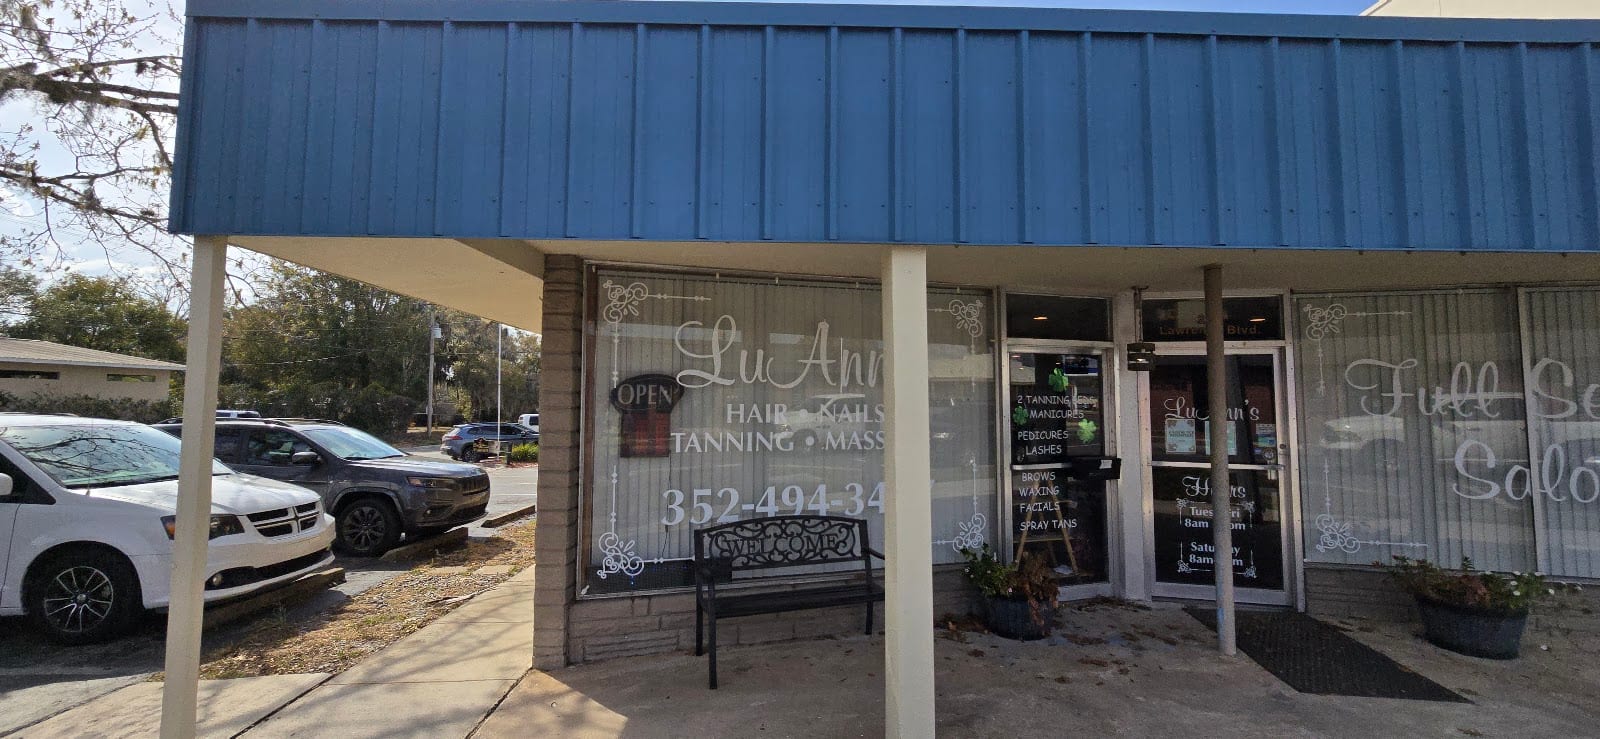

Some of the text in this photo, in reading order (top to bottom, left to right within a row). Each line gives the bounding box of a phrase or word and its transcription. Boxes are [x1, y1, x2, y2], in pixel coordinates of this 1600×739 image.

[617, 383, 673, 405] OPEN
[1345, 358, 1500, 418] Full
[1017, 395, 1023, 404] 2
[1026, 395, 1070, 404] TANNING
[726, 403, 885, 424] HAIR NAILS
[1029, 409, 1084, 419] MANICURES
[1017, 430, 1069, 440] PEDICURES
[670, 431, 794, 453] TANNING
[1025, 445, 1062, 455] LASHES
[1021, 471, 1056, 481] BROWS
[1452, 439, 1600, 504] Salo
[1018, 486, 1060, 497] WAXING
[661, 481, 934, 526] 352-494-34
[1019, 501, 1060, 512] FACIALS
[1020, 518, 1078, 531] SPRAY TANS
[725, 534, 839, 553] WELCOME
